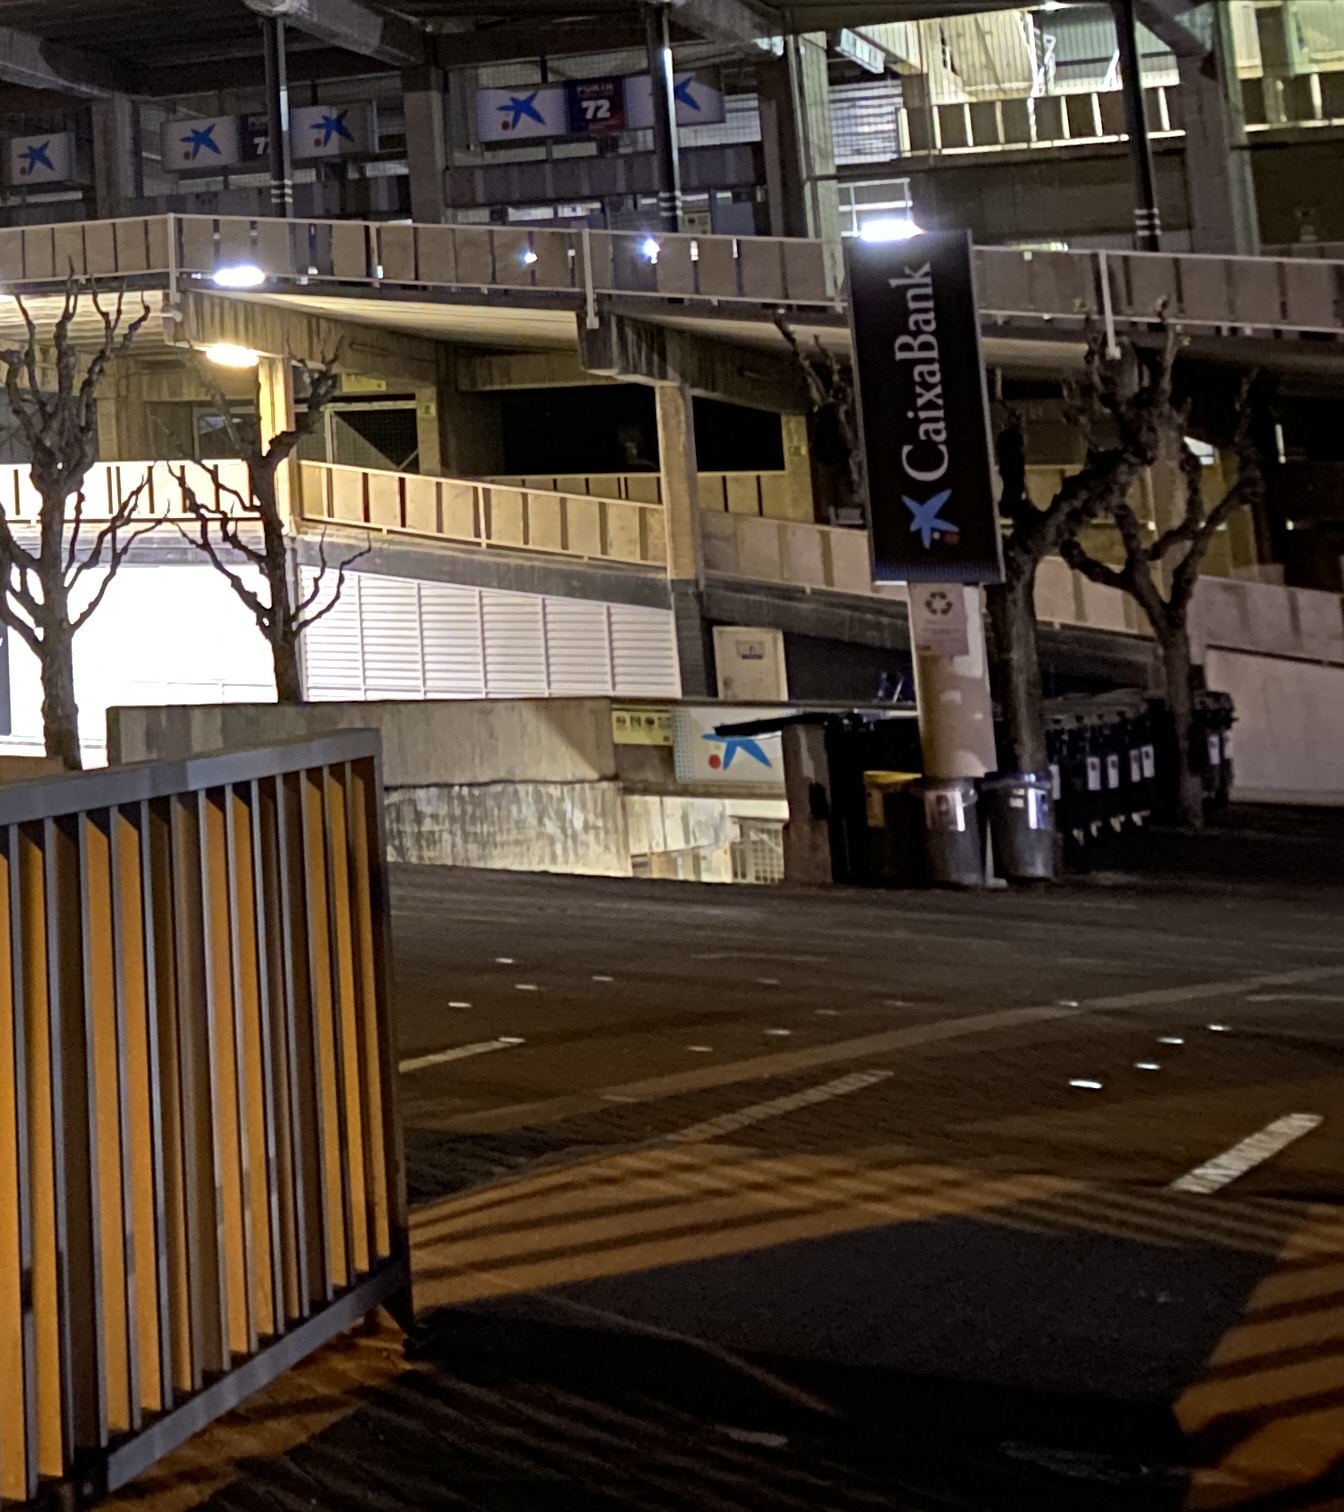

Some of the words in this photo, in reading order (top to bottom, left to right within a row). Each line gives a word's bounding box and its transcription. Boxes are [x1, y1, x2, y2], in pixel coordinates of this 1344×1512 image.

[580, 98, 611, 120] 72
[253, 136, 270, 155] 7
[888, 260, 949, 483] CaixaBank
